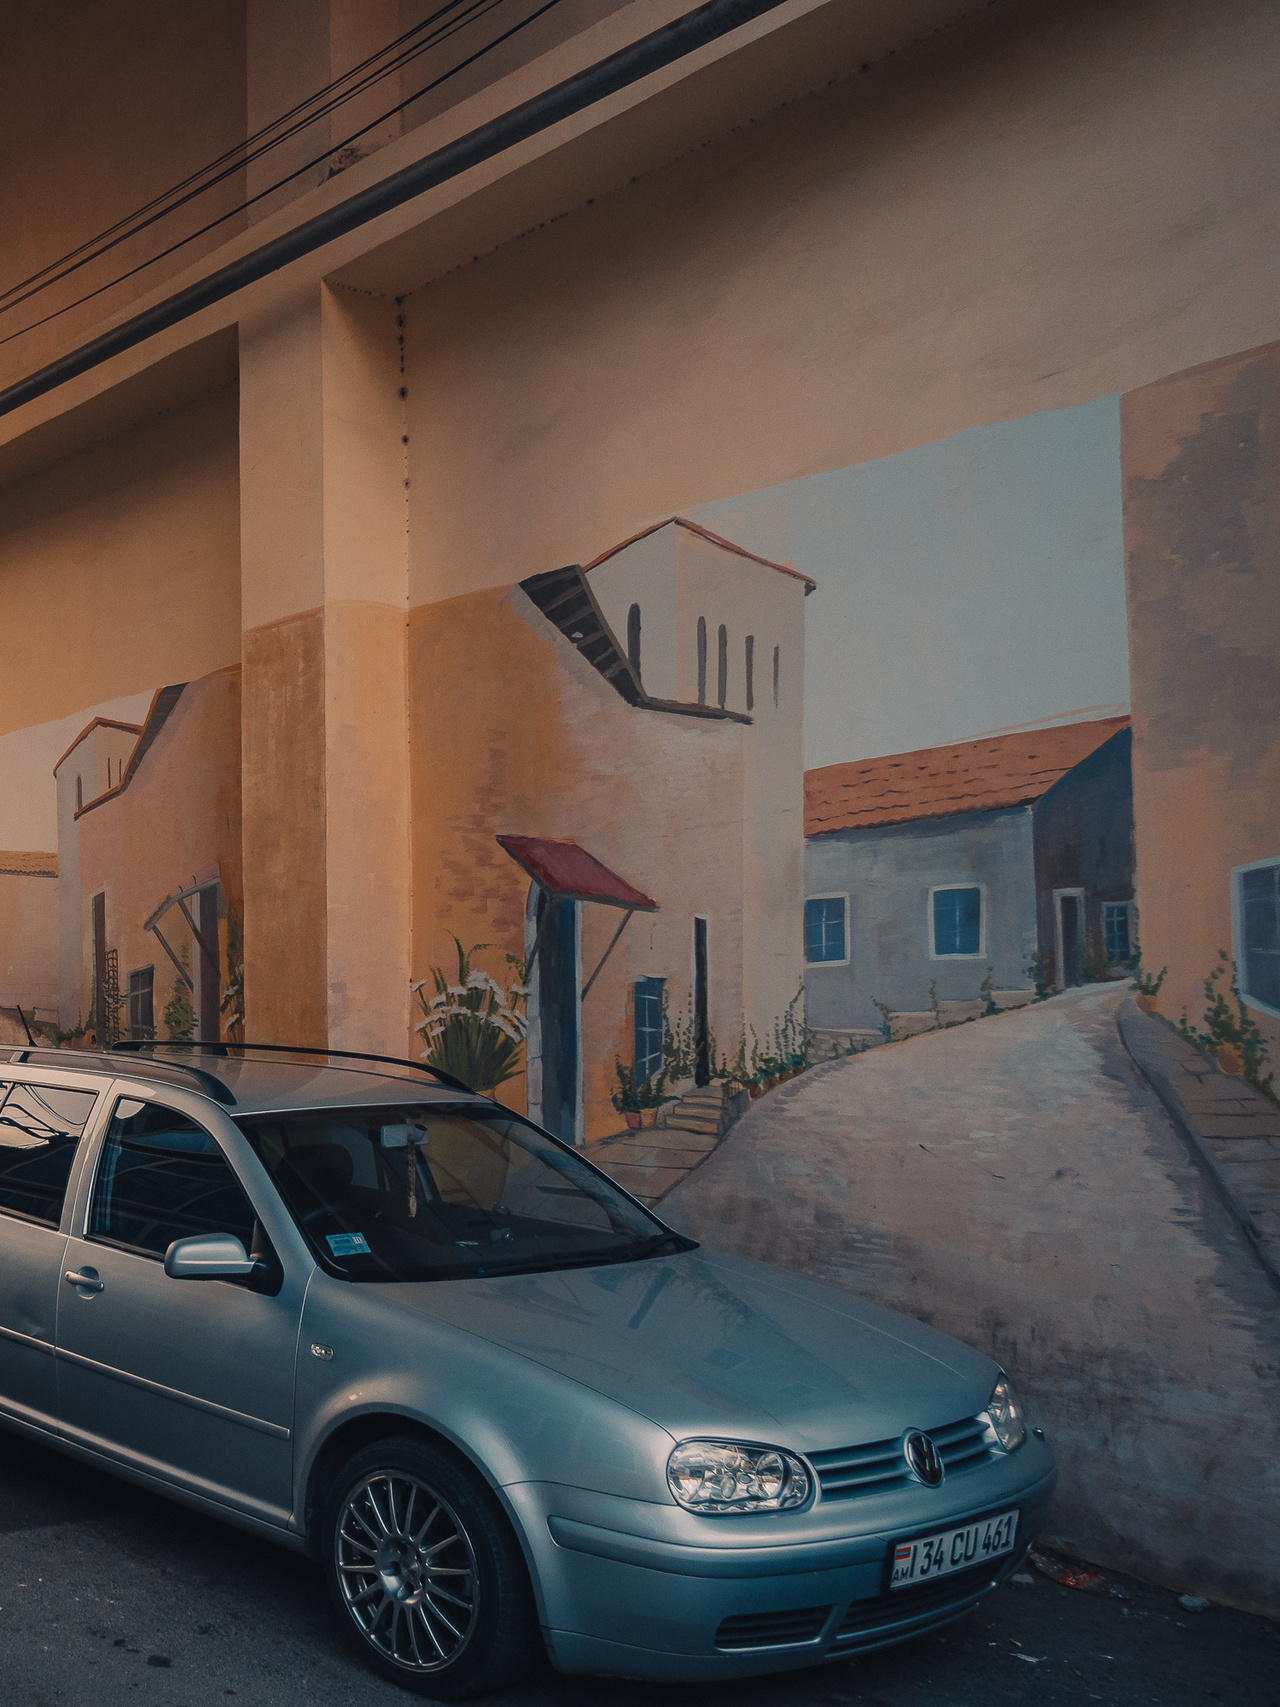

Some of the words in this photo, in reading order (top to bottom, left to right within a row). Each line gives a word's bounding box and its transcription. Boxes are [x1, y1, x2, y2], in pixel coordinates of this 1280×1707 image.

[919, 1537, 944, 1575] 34
[950, 1527, 979, 1566] CU
[982, 1515, 1013, 1555] 461
[892, 1566, 909, 1581] AM
